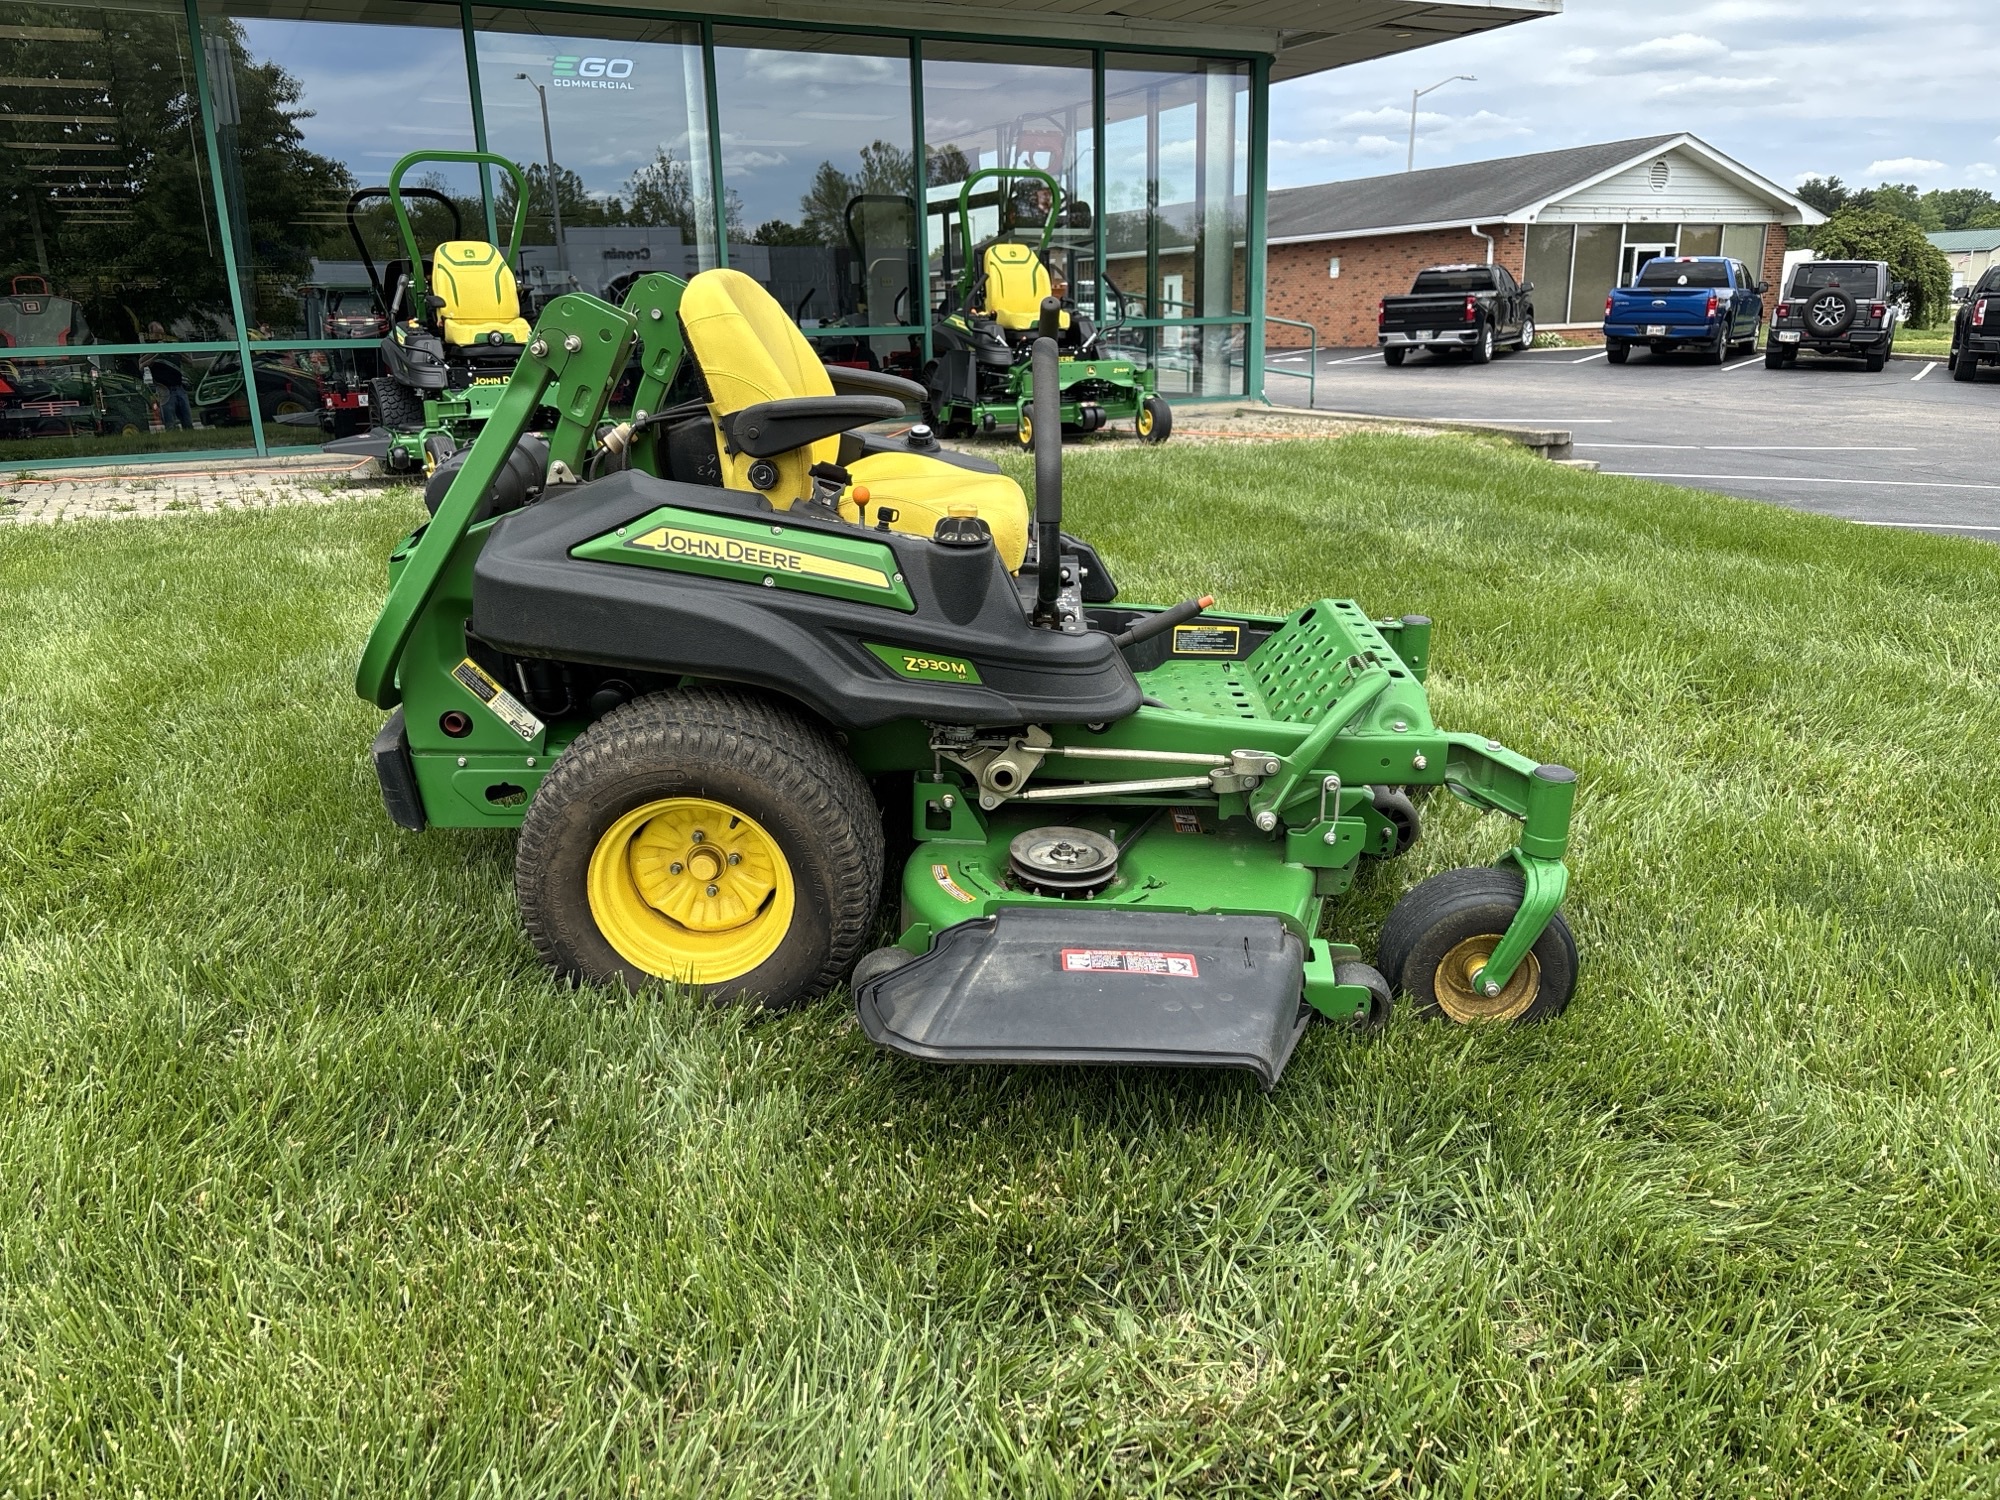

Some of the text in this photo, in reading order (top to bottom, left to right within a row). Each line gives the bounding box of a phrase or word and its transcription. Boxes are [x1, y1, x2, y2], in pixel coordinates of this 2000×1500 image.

[552, 55, 634, 78] EGO
[553, 78, 635, 90] COMMERCIAL
[473, 376, 501, 385] JOHN
[657, 531, 801, 570] JOHN DEERE
[903, 656, 967, 674] Z930M
[476, 668, 495, 687] CAUTION
